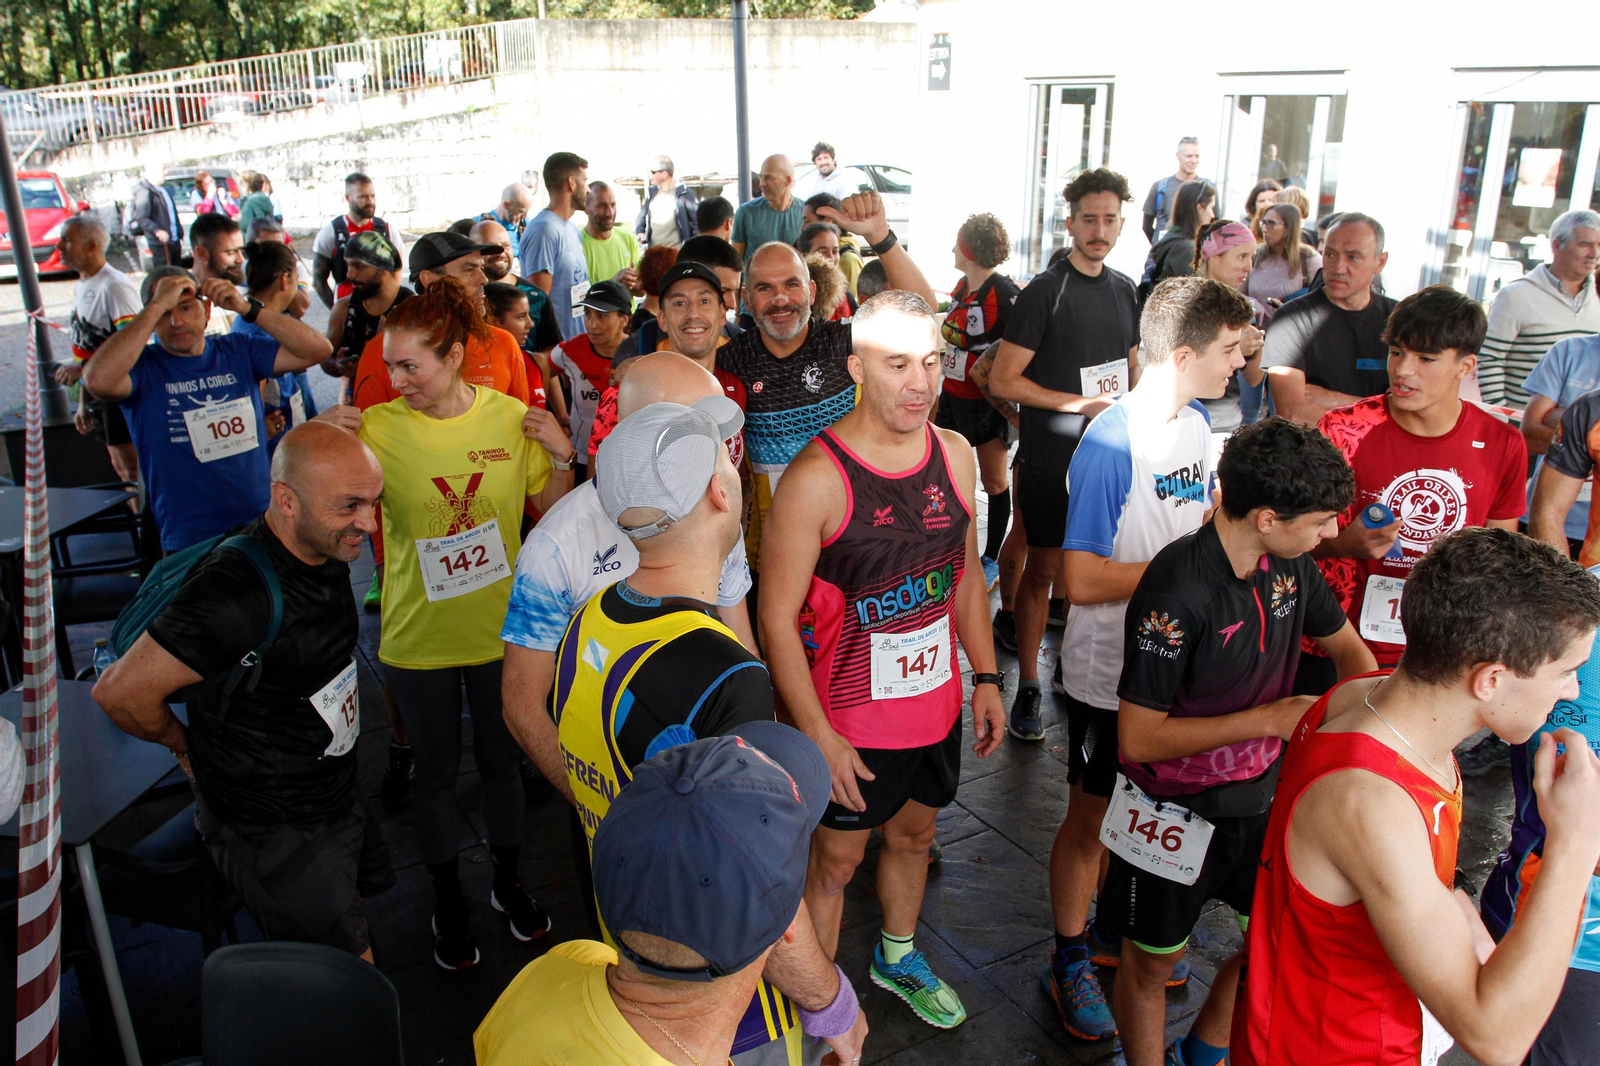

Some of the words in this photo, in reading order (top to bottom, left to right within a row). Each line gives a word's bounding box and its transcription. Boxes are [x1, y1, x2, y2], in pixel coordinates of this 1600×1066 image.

[199, 378, 208, 390] A
[1096, 374, 1119, 394] 106
[580, 388, 602, 402] vé
[206, 416, 245, 440] 108
[1391, 480, 1420, 511] TRAIL
[1424, 480, 1456, 516] ORIXES
[873, 516, 894, 527] ZICO
[1400, 521, 1449, 539] ONDARIZ
[439, 545, 490, 576] 142
[592, 561, 622, 576] ZICO
[896, 644, 939, 679] 147
[1167, 806, 1188, 815] ARCO
[1128, 808, 1185, 852] 146
